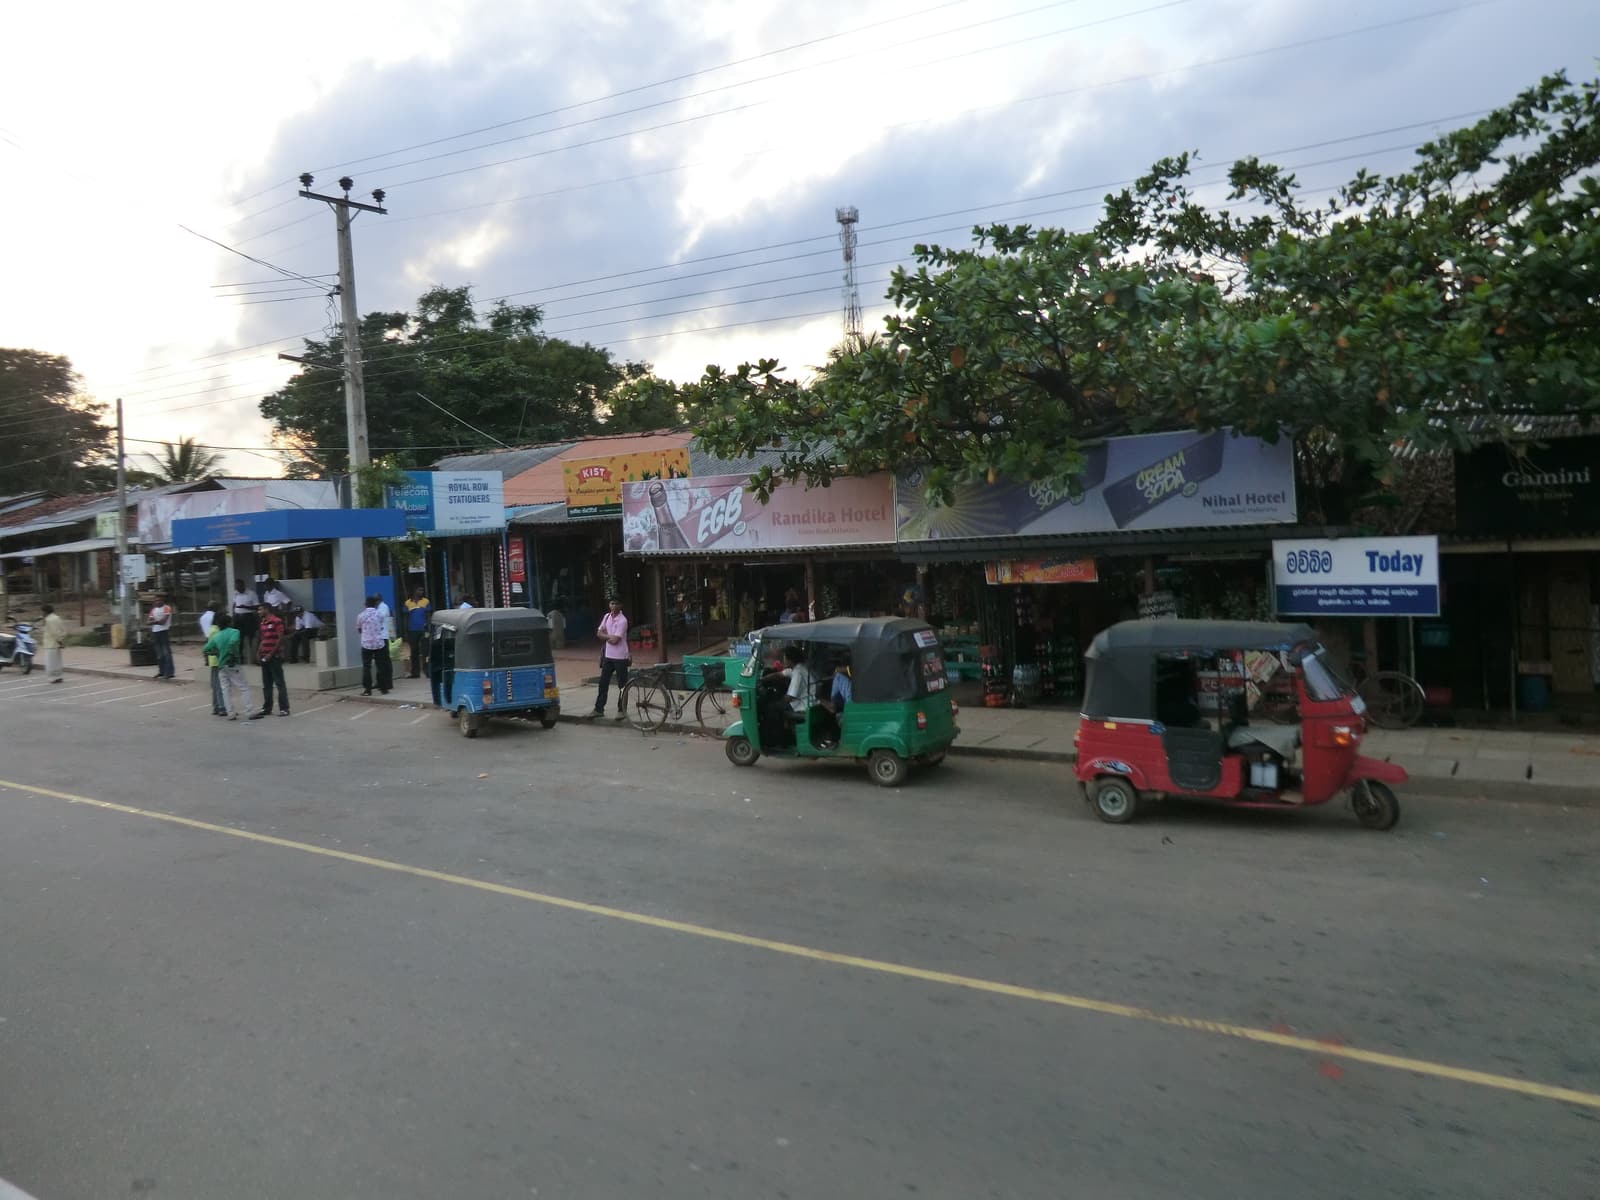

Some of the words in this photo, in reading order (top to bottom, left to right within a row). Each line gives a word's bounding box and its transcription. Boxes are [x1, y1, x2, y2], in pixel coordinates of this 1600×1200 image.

[582, 466, 606, 479] KIST
[1135, 451, 1186, 491] CREAM
[1501, 465, 1590, 488] Gamini
[388, 486, 430, 497] Telecom
[448, 482, 471, 493] ROYAL
[472, 481, 489, 492] ROW
[1144, 471, 1186, 504] SODA
[448, 494, 491, 504] STATIONERS
[1202, 492, 1241, 508] Nihal
[1245, 490, 1286, 506] Hotel
[696, 485, 744, 544] EGB
[771, 508, 836, 526] Randika
[841, 504, 886, 523] Hotel
[1365, 550, 1423, 577] Today
